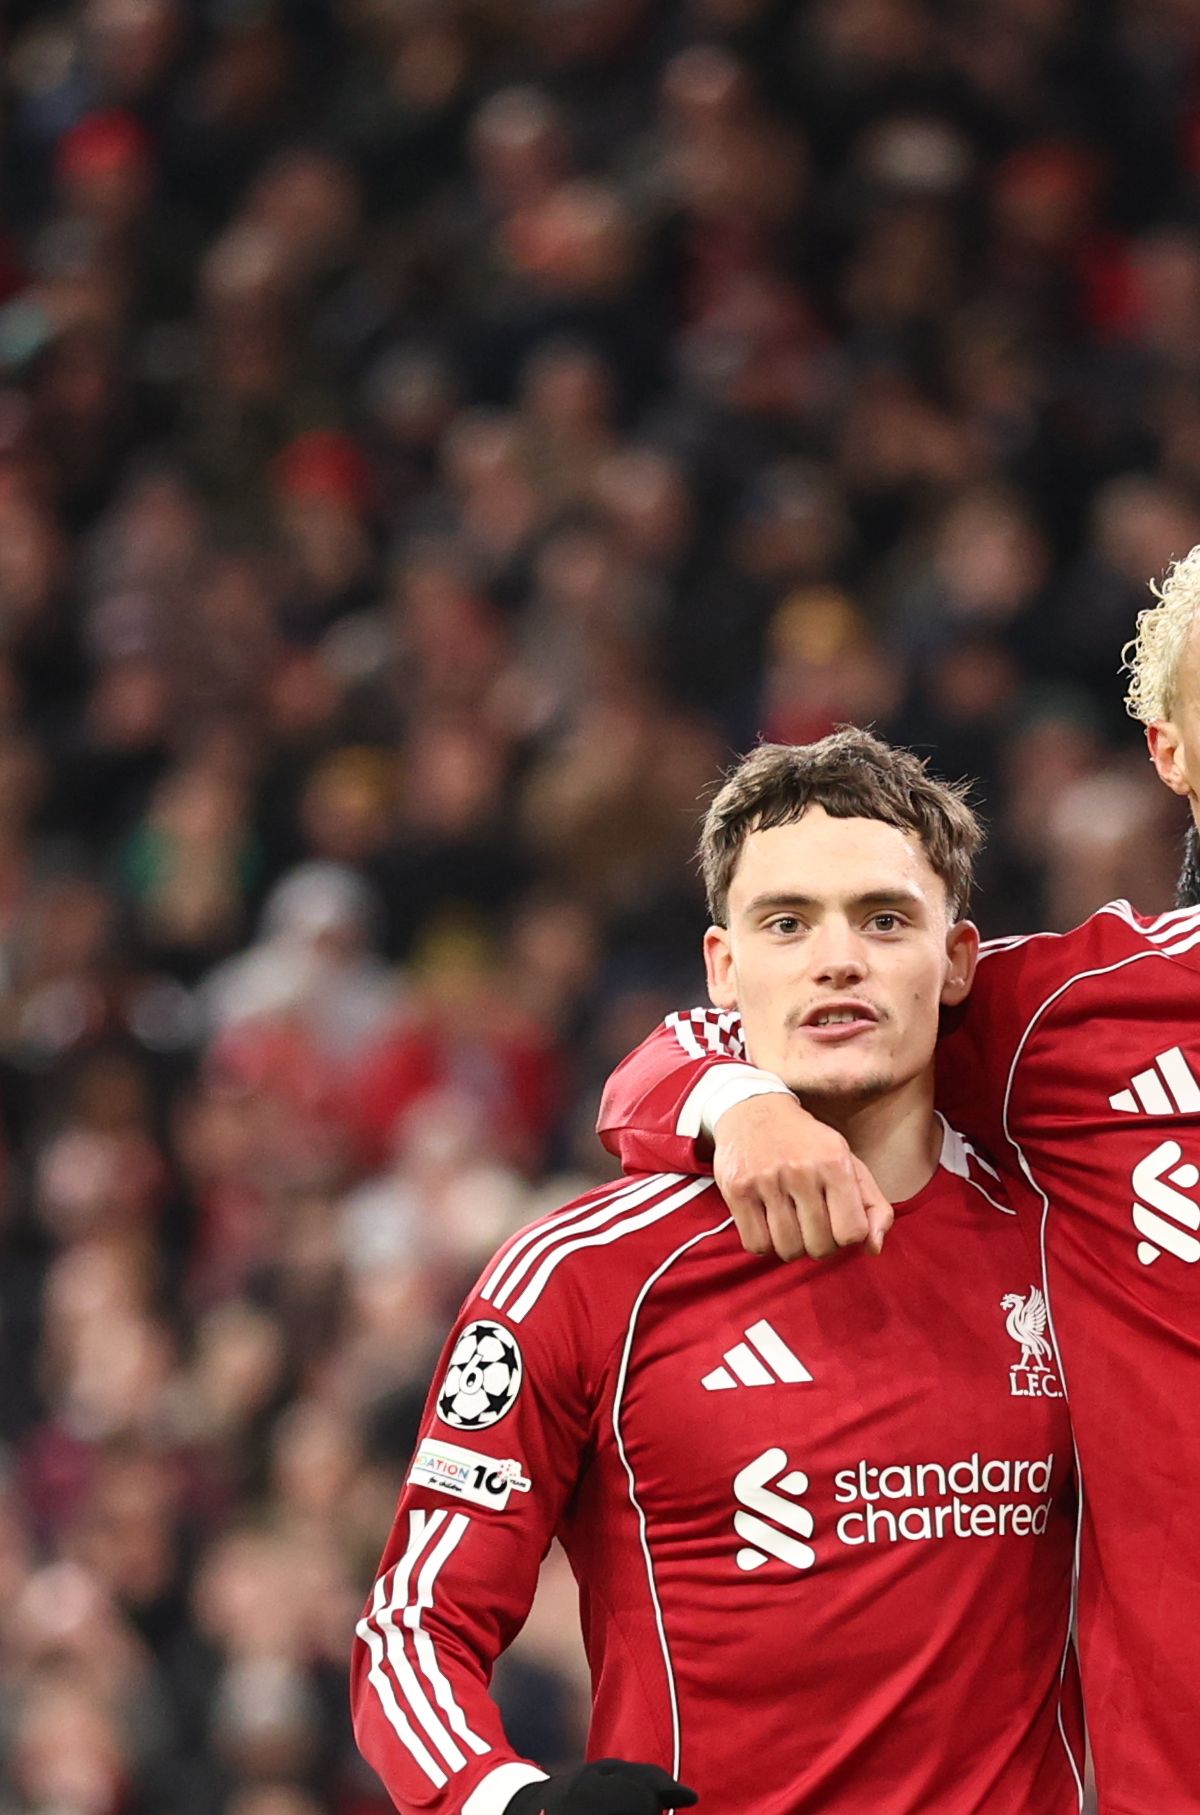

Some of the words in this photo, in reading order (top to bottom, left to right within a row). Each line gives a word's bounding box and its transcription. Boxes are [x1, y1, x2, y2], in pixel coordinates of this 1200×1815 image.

[1009, 1372, 1064, 1398] L.F.C.
[834, 1452, 1053, 1503] standard
[836, 1497, 1053, 1546] chartered
